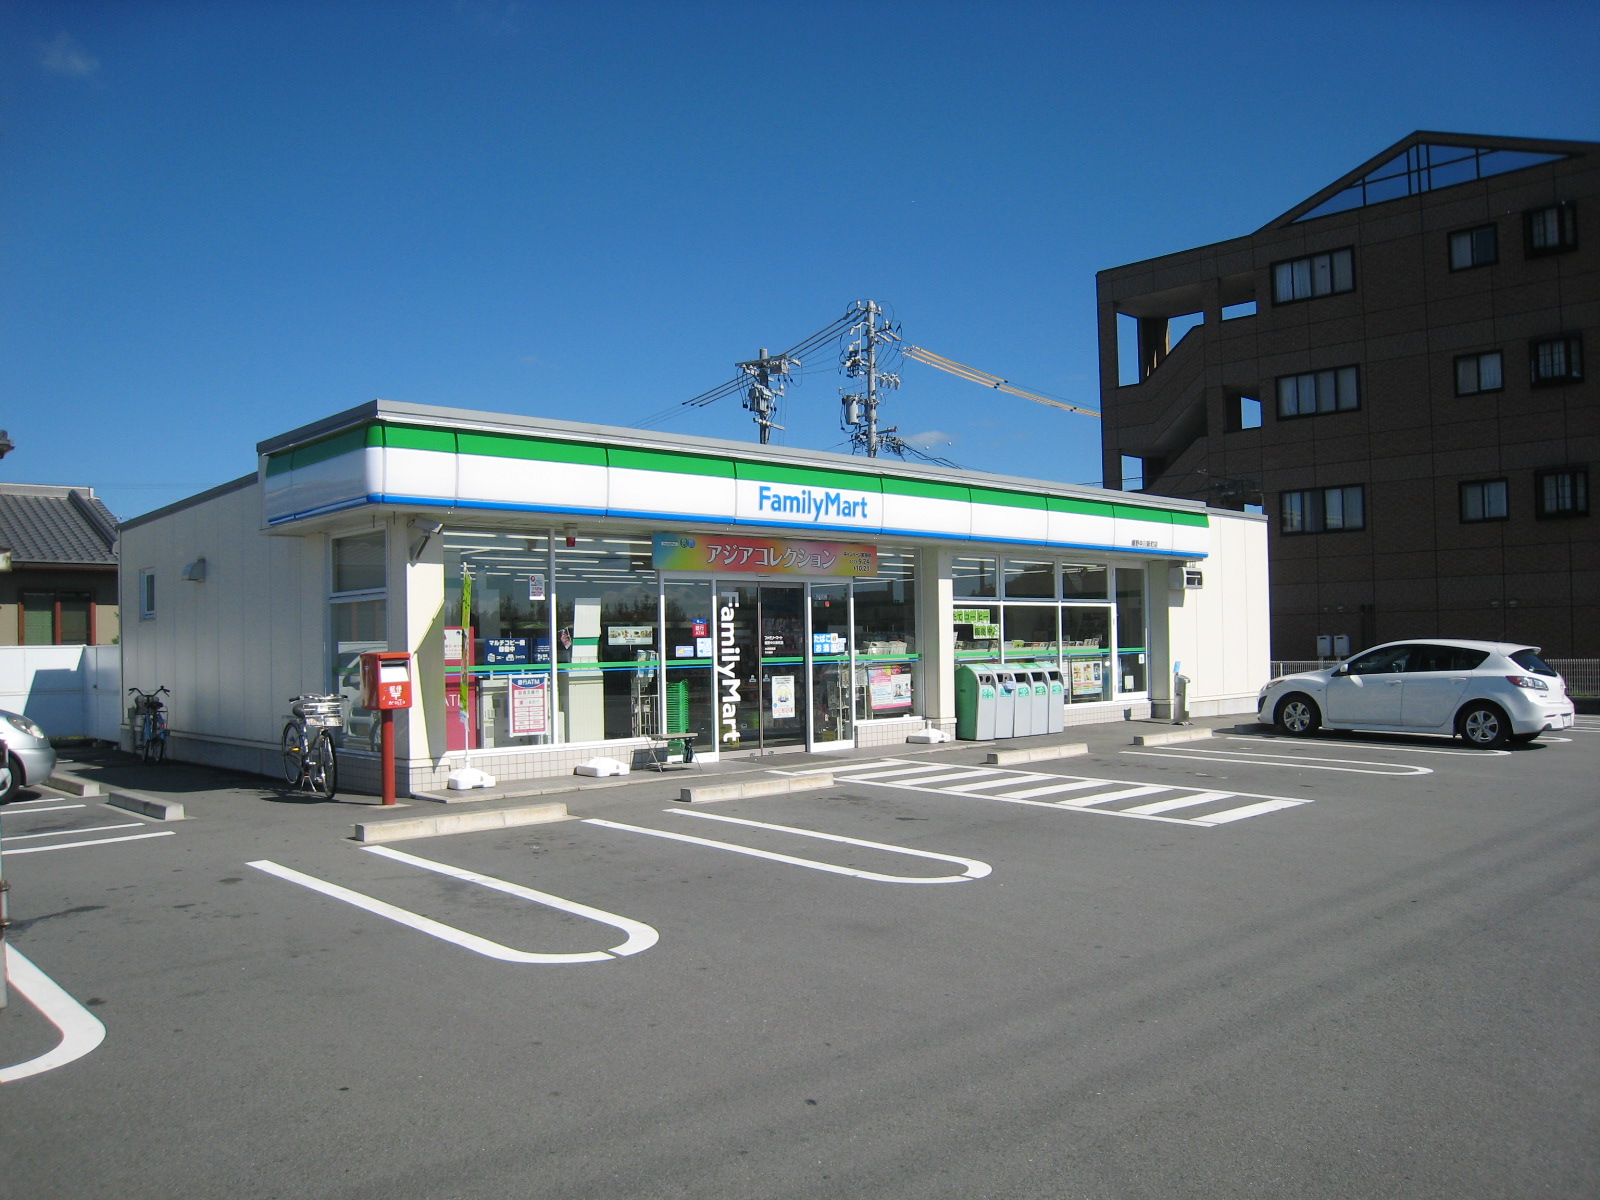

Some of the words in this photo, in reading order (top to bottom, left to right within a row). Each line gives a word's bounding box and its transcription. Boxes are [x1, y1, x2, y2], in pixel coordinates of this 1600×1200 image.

[759, 485, 868, 521] FamilyMart
[707, 544, 837, 570] アジアコレクション
[717, 591, 741, 742] FamilyMart
